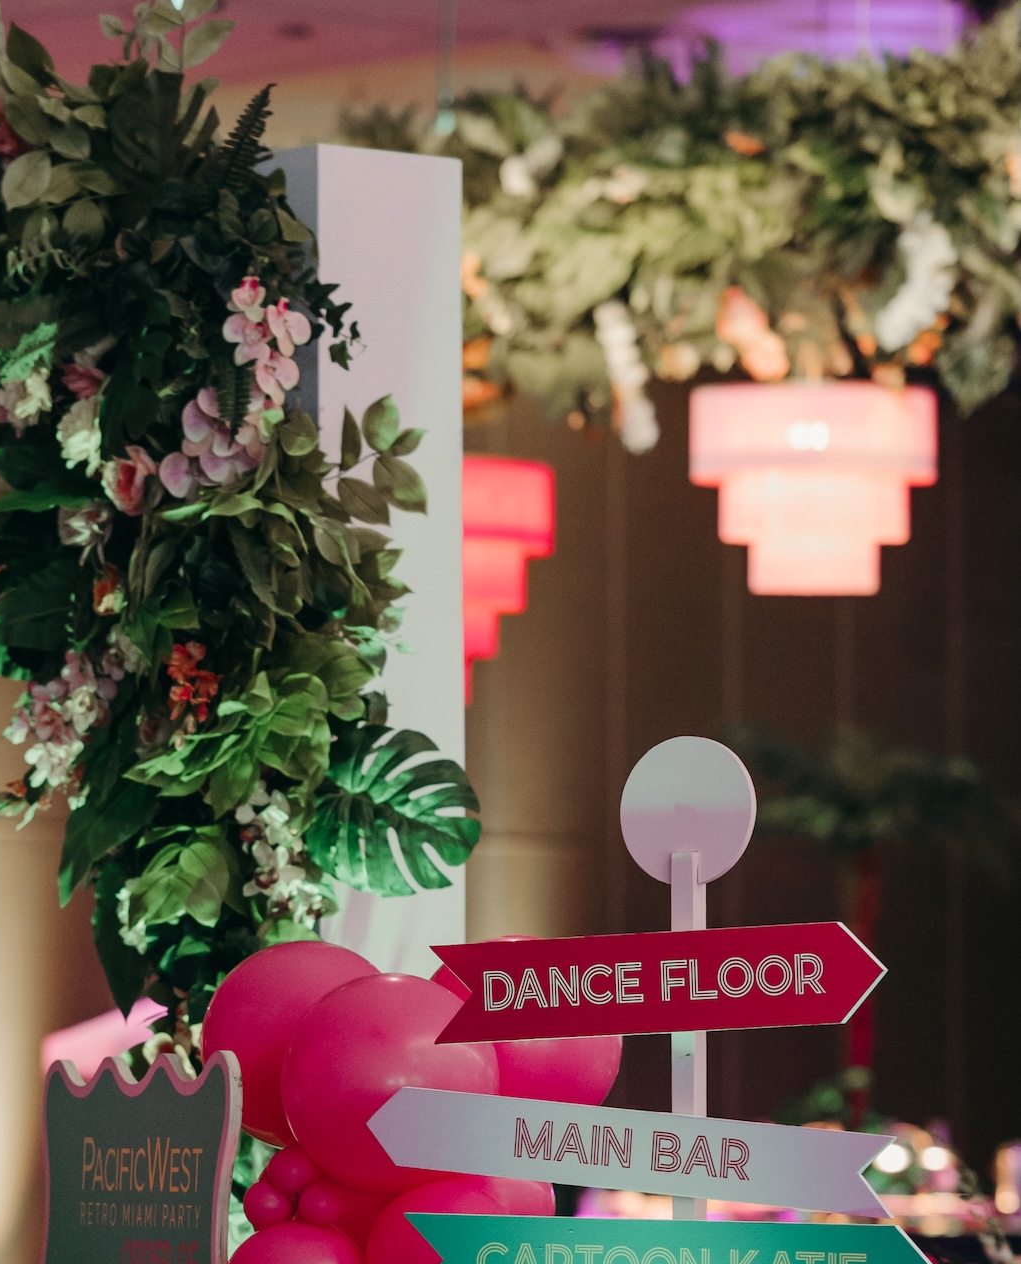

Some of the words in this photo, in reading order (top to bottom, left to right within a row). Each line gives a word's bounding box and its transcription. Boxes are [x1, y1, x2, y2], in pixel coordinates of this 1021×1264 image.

[483, 961, 643, 1012] DANCE
[659, 952, 826, 1002] FLOOR
[513, 1117, 632, 1169] MAIN
[650, 1130, 749, 1181] BAR
[80, 1202, 117, 1226] RETRO
[122, 1203, 157, 1227] MIAMI
[162, 1205, 201, 1229] PARTY
